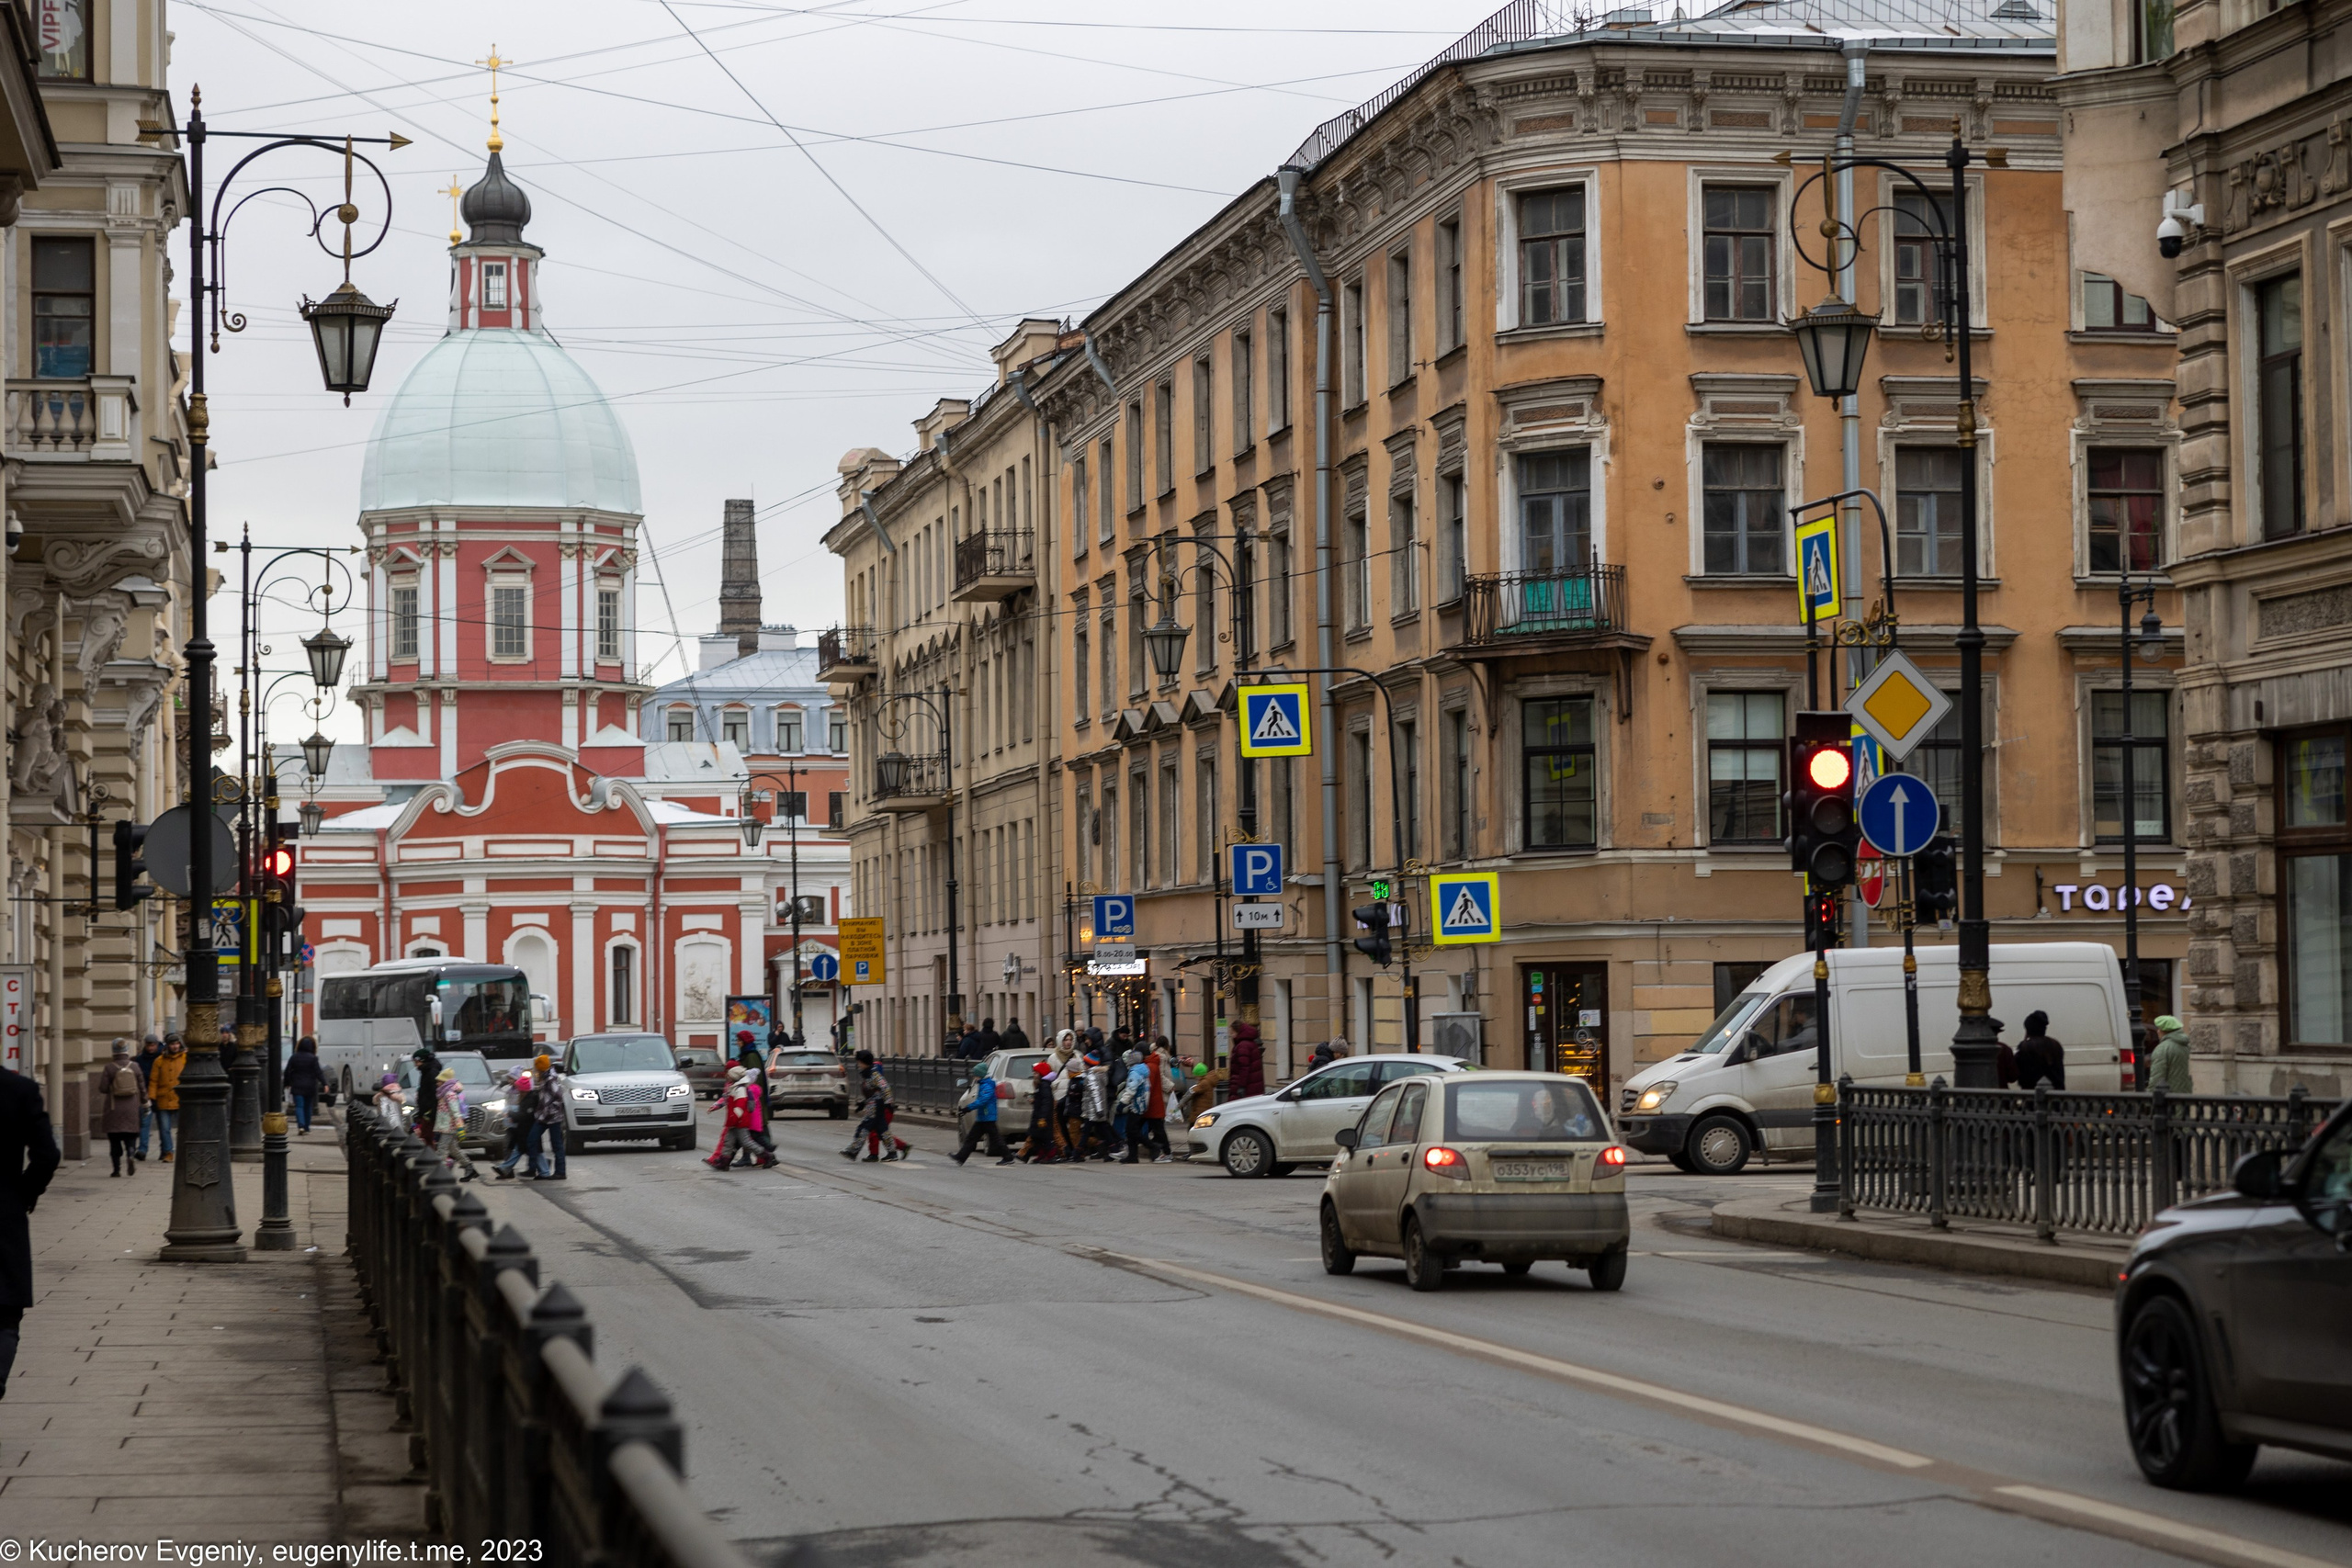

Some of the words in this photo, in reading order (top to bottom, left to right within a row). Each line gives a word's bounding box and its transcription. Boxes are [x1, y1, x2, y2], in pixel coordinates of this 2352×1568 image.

[1246, 850, 1273, 889] P
[1104, 899, 1127, 932] P
[6, 979, 20, 1075] СТОЛ
